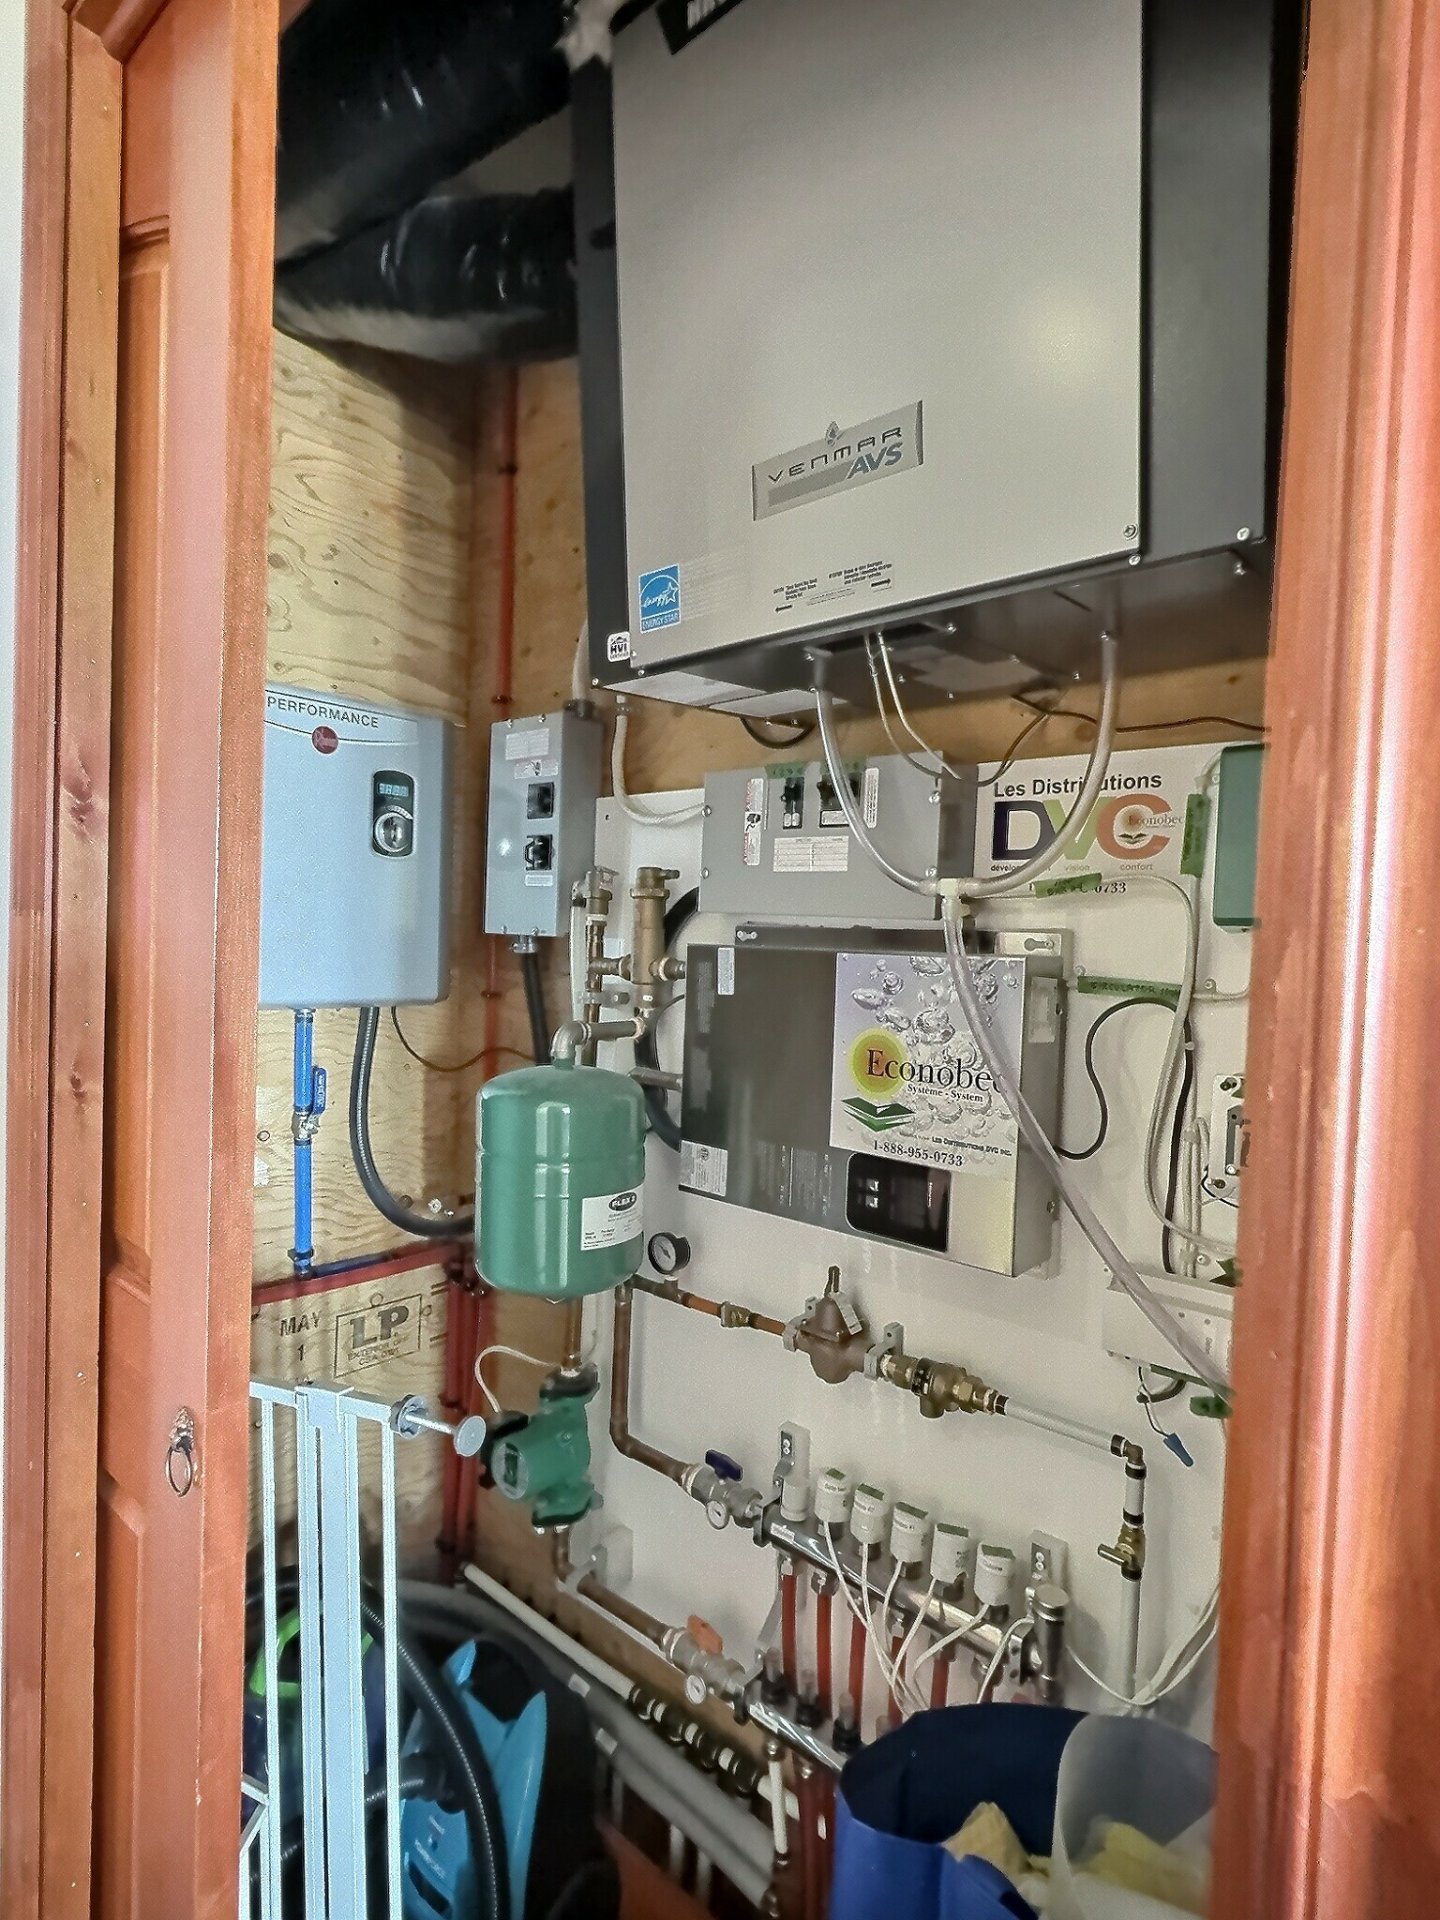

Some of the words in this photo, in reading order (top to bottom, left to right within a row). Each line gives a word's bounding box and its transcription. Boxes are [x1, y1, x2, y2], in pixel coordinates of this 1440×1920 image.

[768, 427, 902, 482] VENMAR
[846, 442, 903, 479] AVS
[642, 617, 664, 630] ENERGY
[664, 612, 679, 625] STAR
[610, 643, 628, 655] HVI
[267, 696, 380, 729] PERFORMANCE
[993, 781, 1026, 798] Les
[1033, 774, 1163, 794] Distriutions
[992, 793, 1172, 860] DVC
[1064, 863, 1091, 872] vision
[1120, 862, 1154, 872] confort
[907, 1084, 943, 1097] Système
[950, 1090, 984, 1103] System
[873, 1139, 964, 1167] 1-888-955-0733
[280, 1310, 321, 1337] MAY
[350, 1305, 410, 1350] LP
